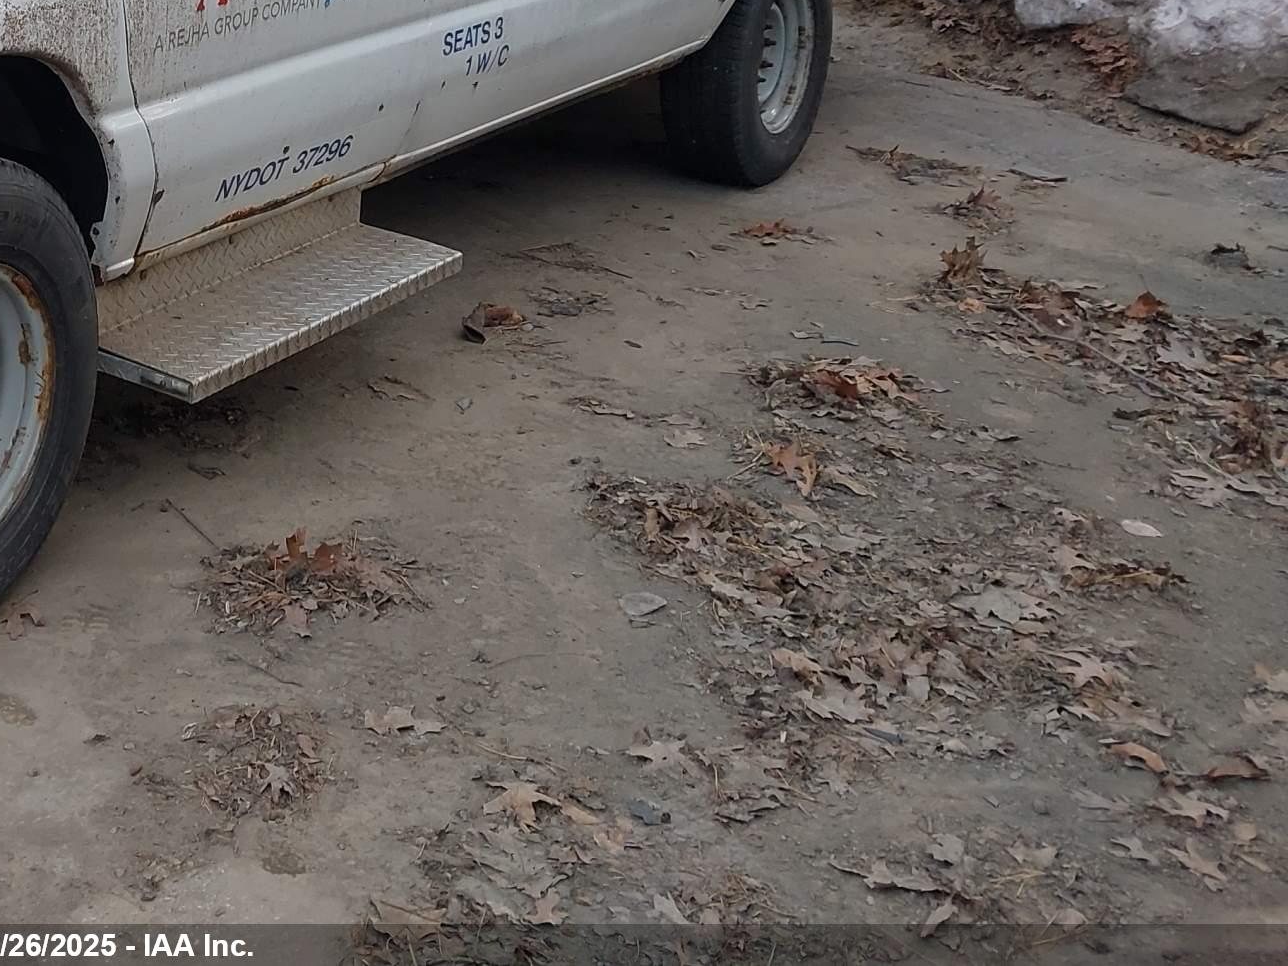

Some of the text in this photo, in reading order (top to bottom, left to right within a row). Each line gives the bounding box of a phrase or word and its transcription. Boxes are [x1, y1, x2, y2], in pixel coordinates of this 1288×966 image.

[168, 22, 210, 52] REJHA
[214, 6, 260, 36] GROUP
[443, 16, 504, 56] SEATS 3
[465, 44, 510, 76] 1 W/C
[214, 135, 354, 202] NYDOT 37296
